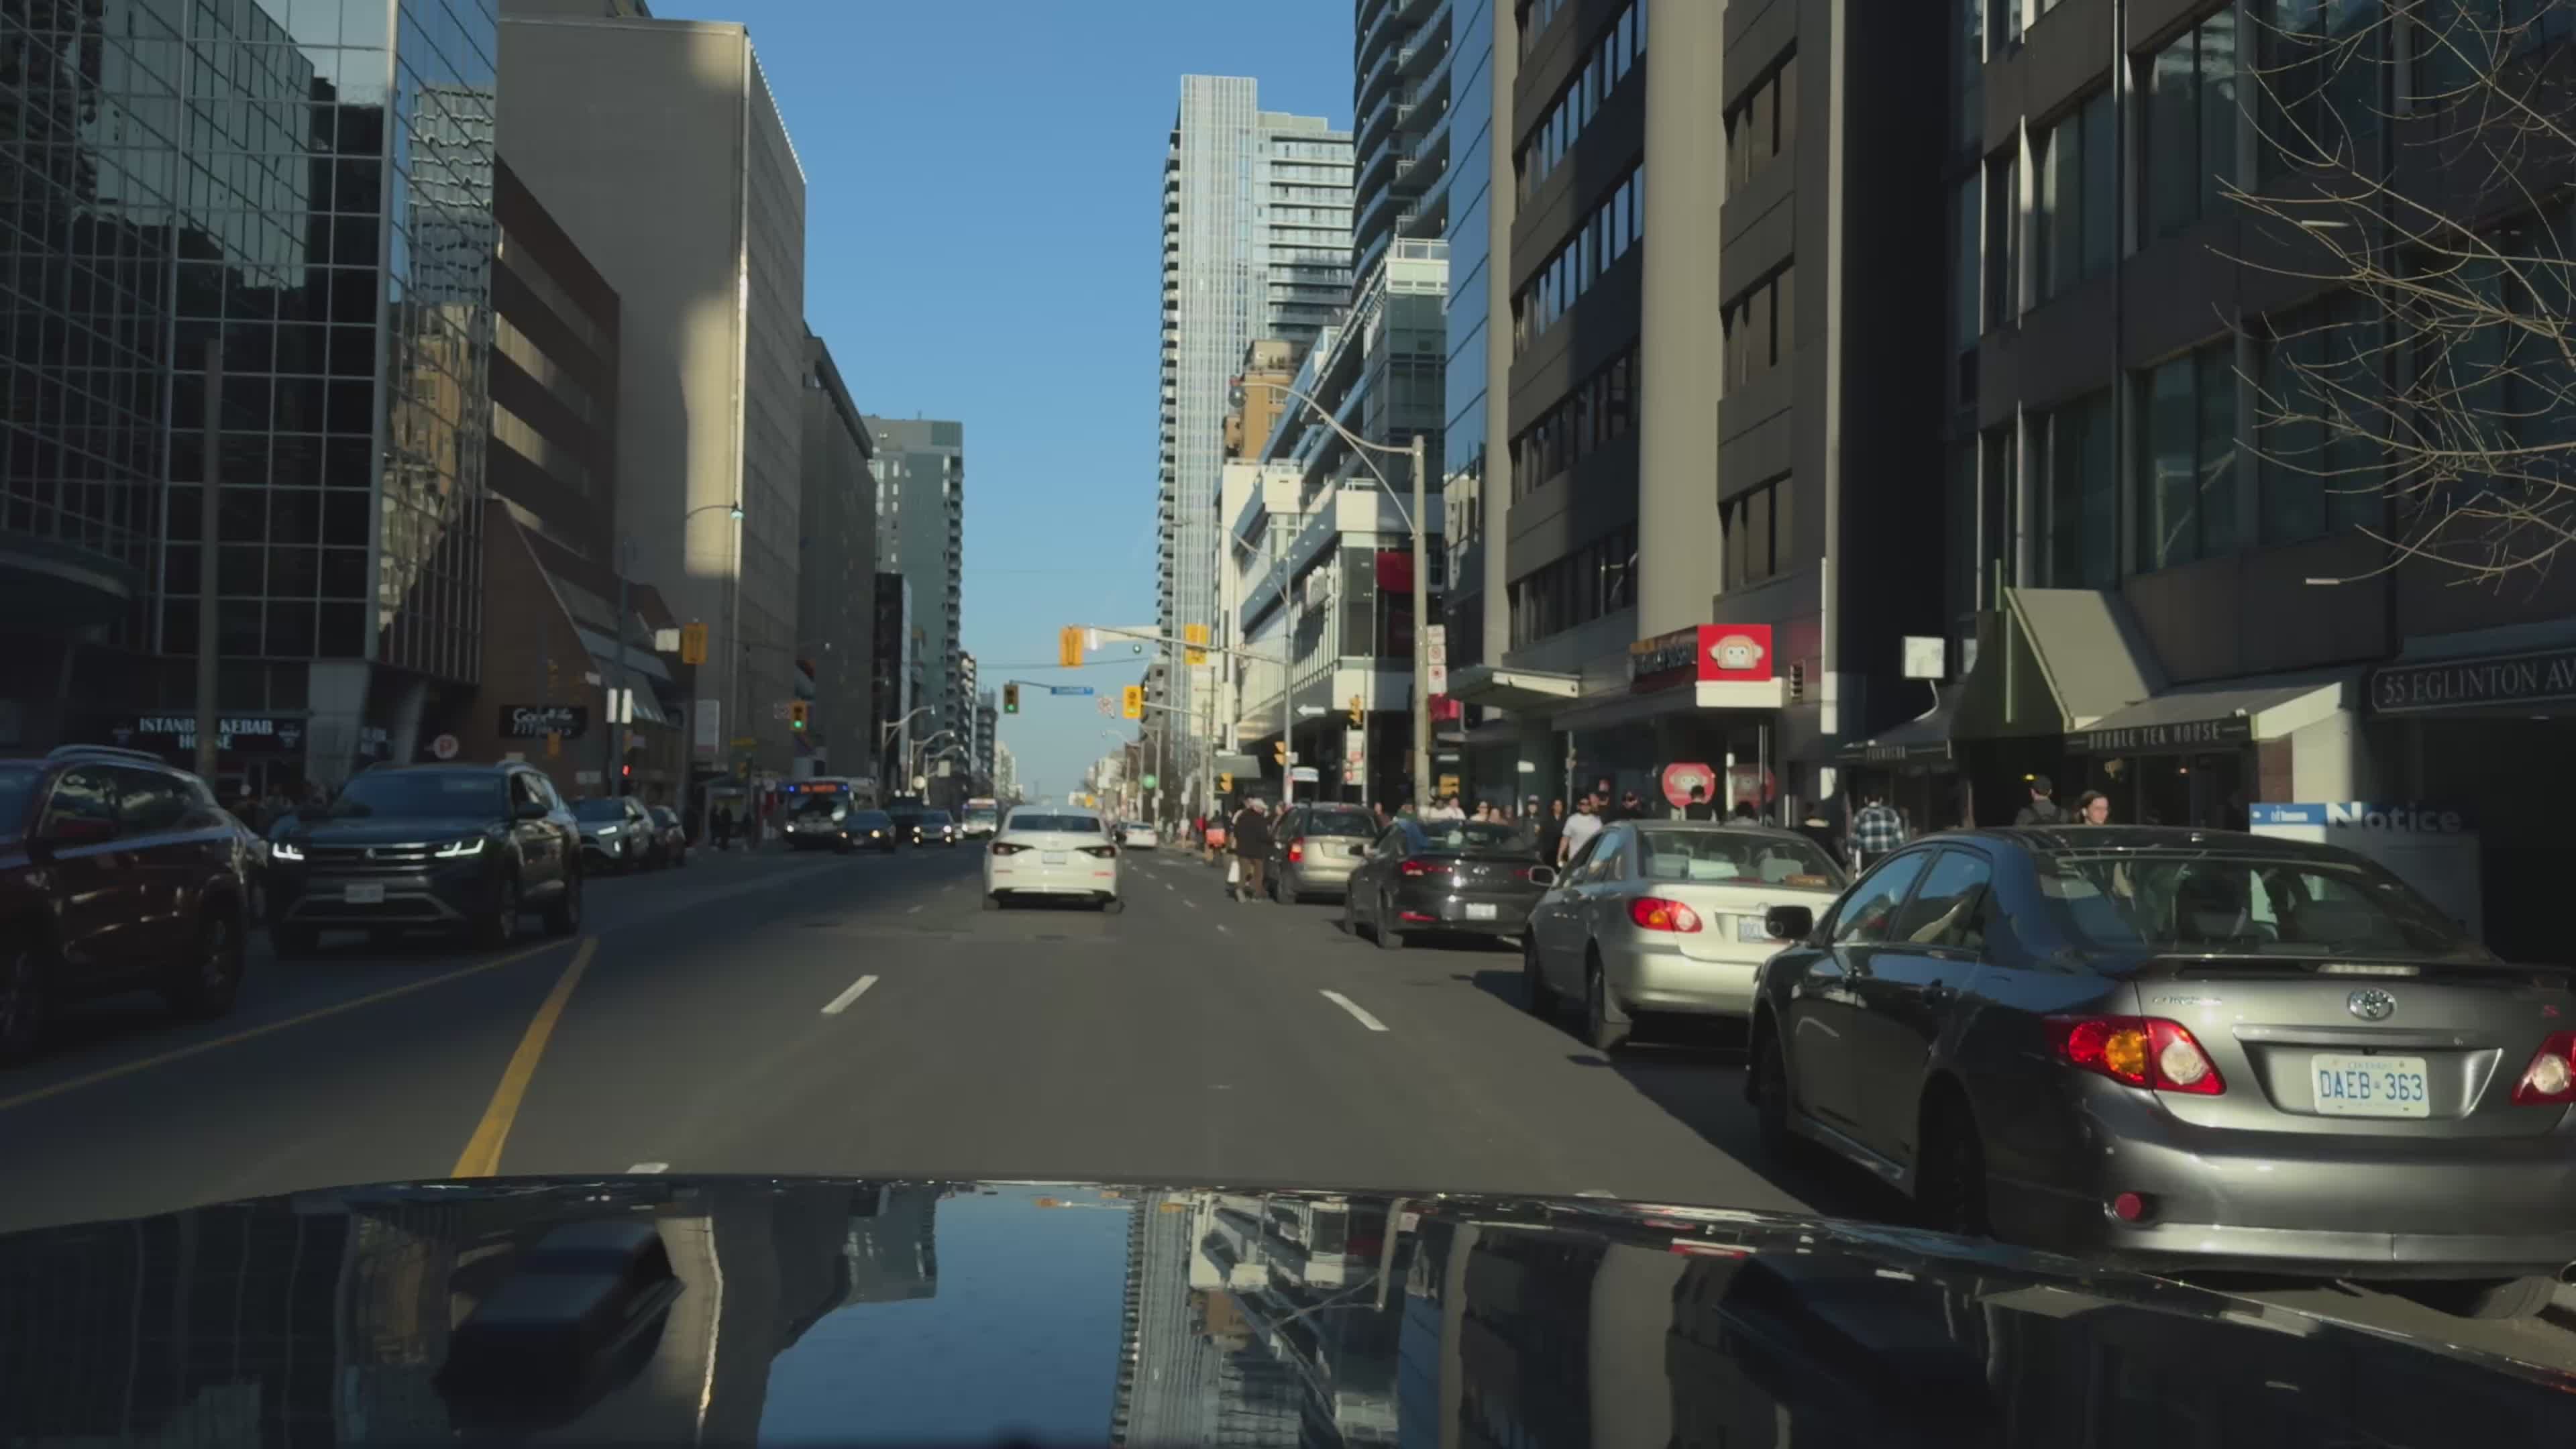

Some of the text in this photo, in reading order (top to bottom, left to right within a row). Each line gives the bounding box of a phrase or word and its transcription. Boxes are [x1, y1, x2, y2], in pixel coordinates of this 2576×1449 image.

[2383, 675, 2405, 704] 55
[2412, 661, 2538, 702] EGLINTON
[140, 716, 274, 735] ISTANB KEBAB
[2088, 721, 2220, 750] BUBBLE TEA HOUSE
[178, 735, 233, 750] HOSE
[2325, 800, 2462, 832] Notice
[2319, 1070, 2423, 1101] DAEB 363
